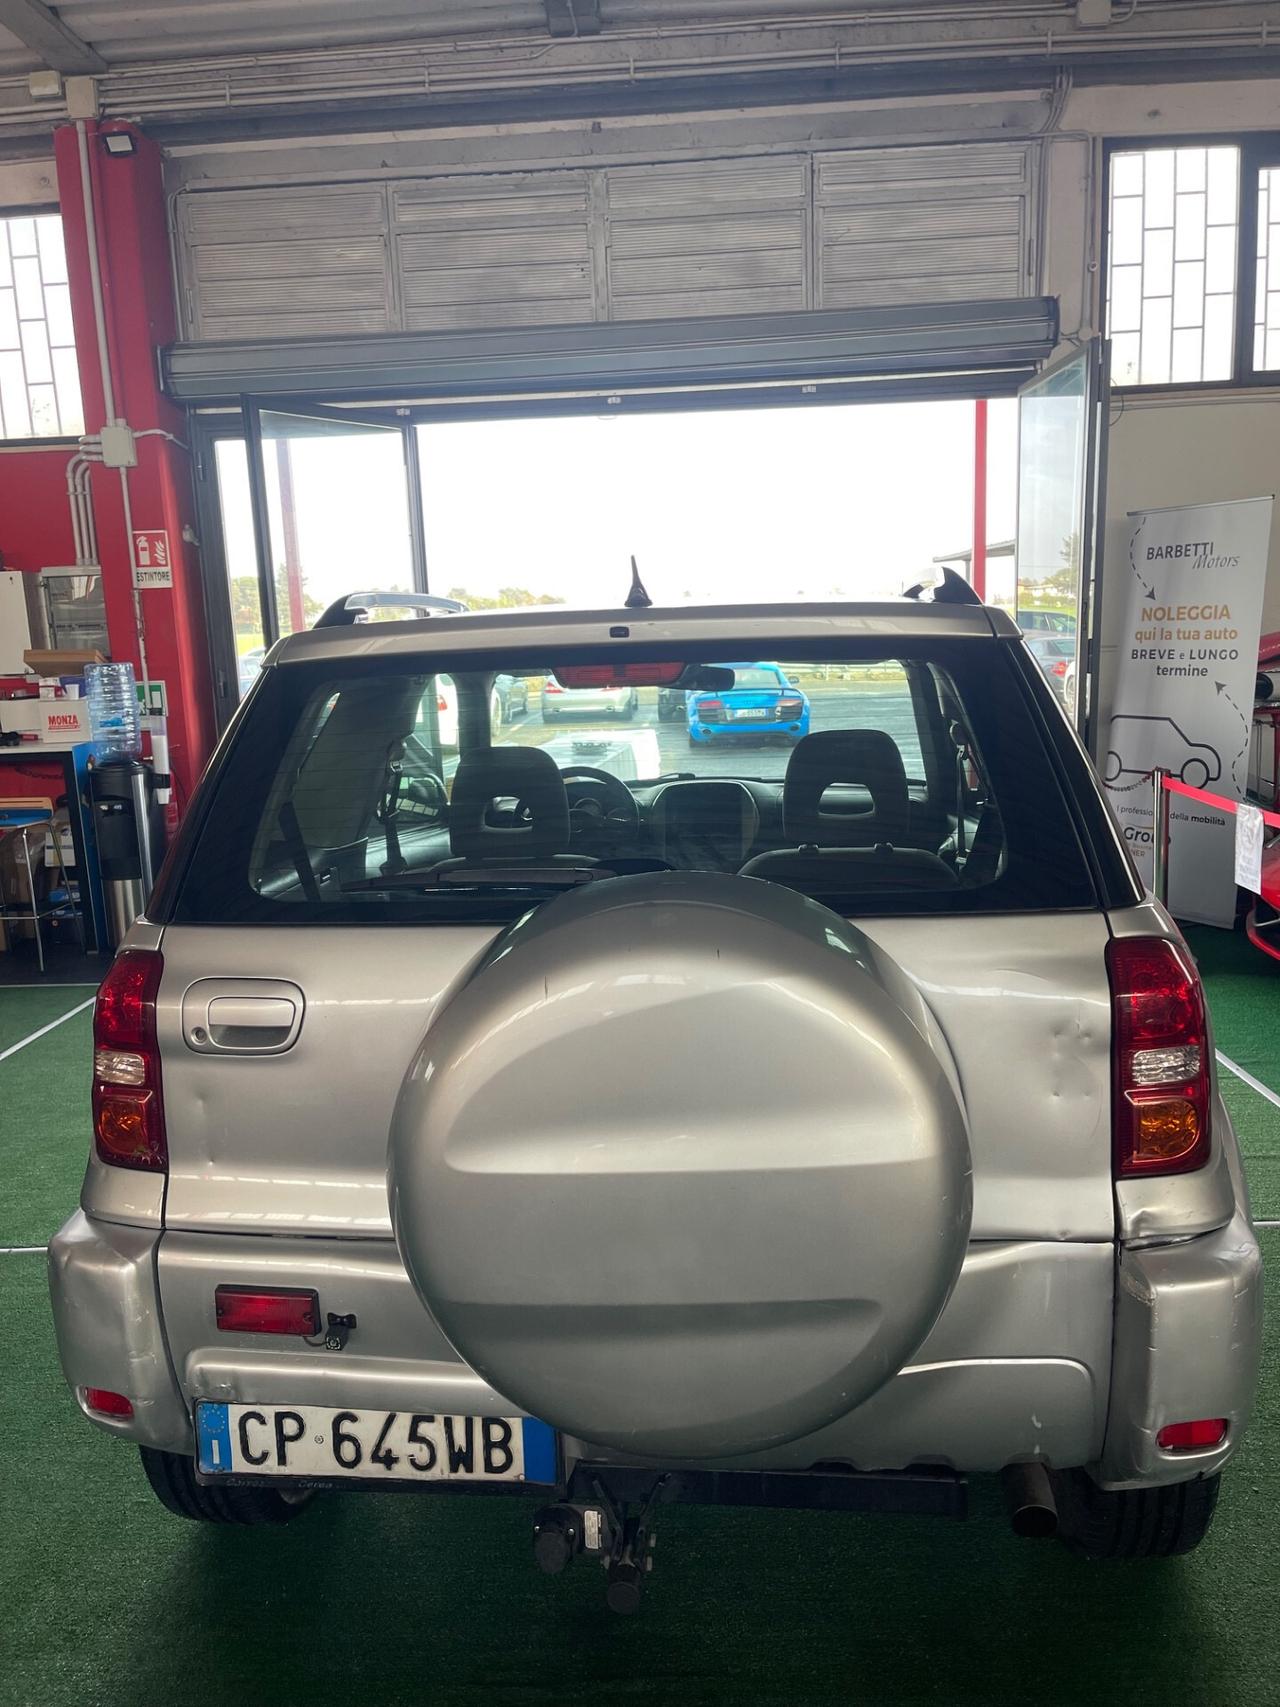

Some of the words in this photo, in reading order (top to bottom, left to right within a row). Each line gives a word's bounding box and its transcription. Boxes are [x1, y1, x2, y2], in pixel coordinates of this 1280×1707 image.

[1146, 541, 1214, 561] BARBETTI
[1191, 554, 1241, 570] Motors
[136, 570, 171, 582] ESTINTORE
[1141, 604, 1231, 622] NOLEGGIA
[1135, 626, 1157, 644] qui
[1160, 627, 1173, 641] la
[1176, 628, 1201, 641] tua
[1204, 627, 1239, 641] auto
[1131, 648, 1176, 660] BREVE
[1189, 648, 1239, 660] LUNGO
[1156, 663, 1208, 677] termine
[47, 714, 79, 726] MONZA
[1120, 806, 1153, 818] professio
[1169, 811, 1190, 822] della
[1190, 814, 1226, 826] mobilità
[1123, 826, 1172, 846] Gro
[238, 1410, 305, 1467] CP
[331, 1411, 514, 1475] 645WB
